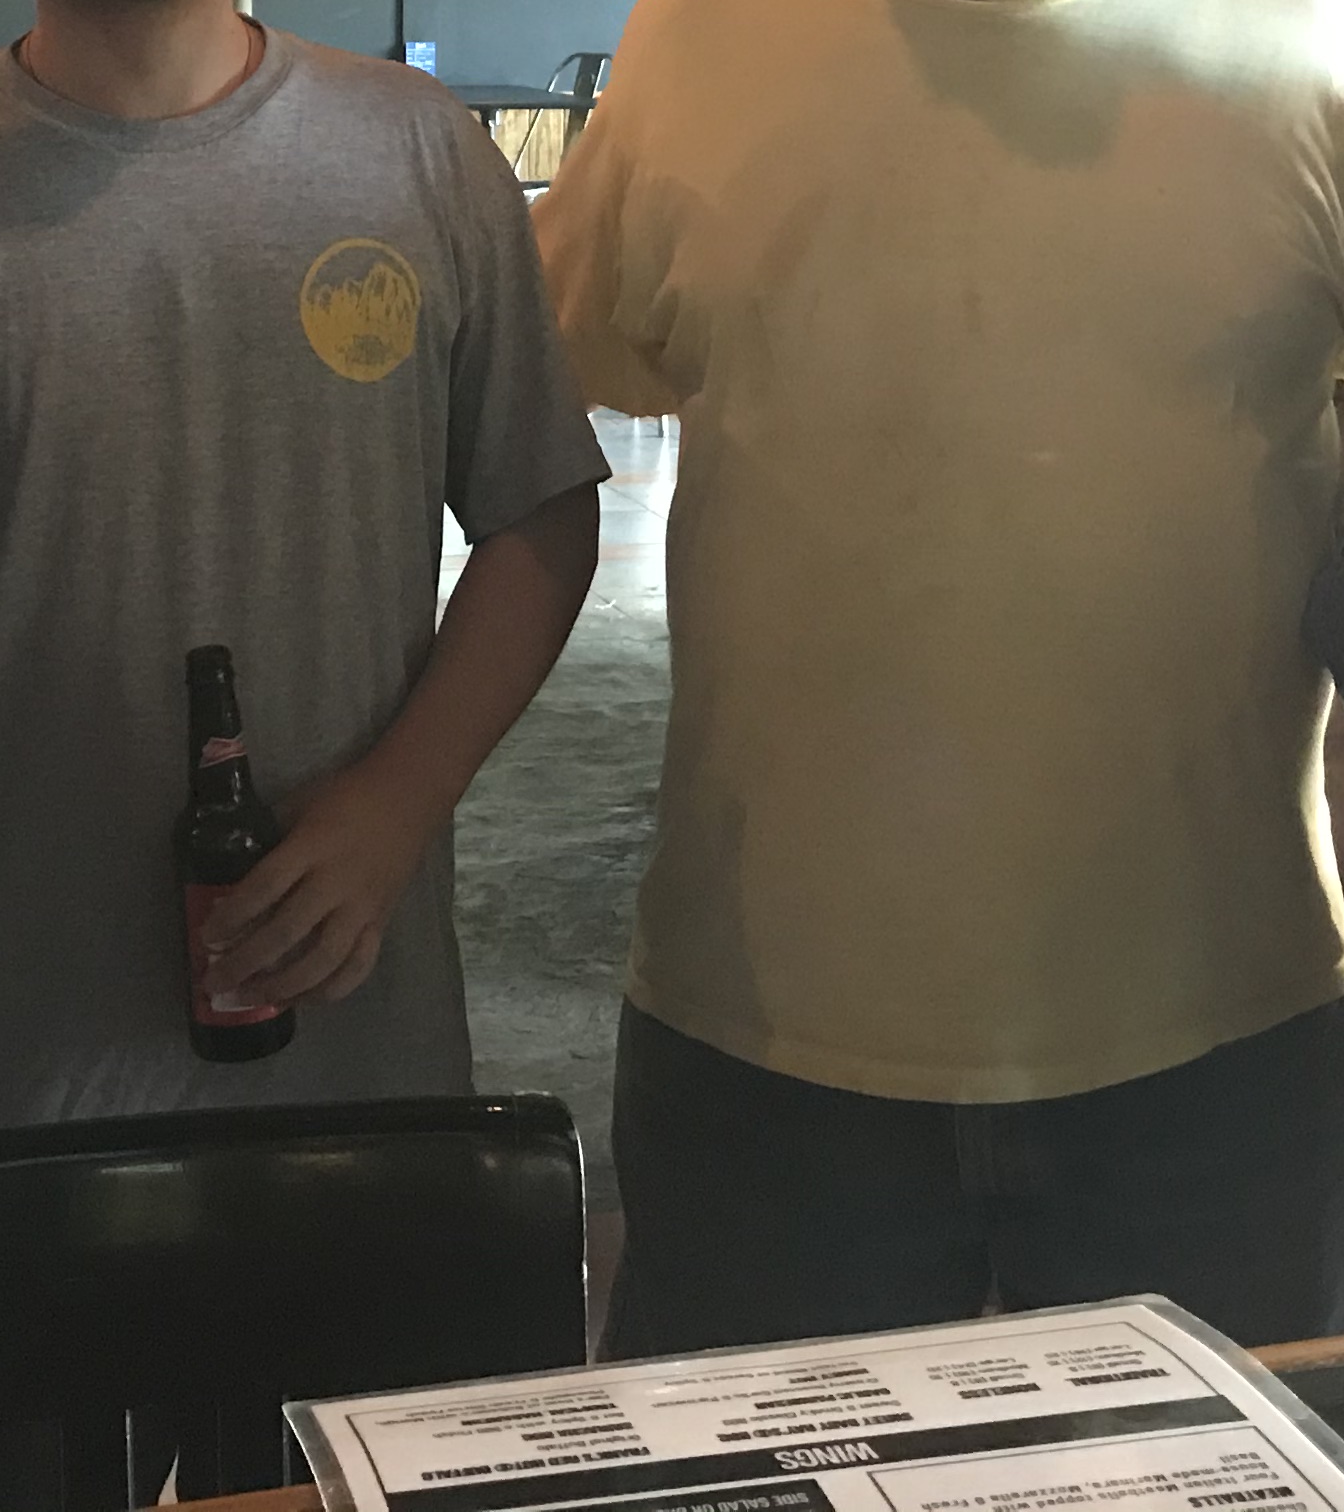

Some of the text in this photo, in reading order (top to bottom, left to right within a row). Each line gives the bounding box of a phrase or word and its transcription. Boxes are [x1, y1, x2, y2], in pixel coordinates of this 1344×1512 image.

[774, 1441, 879, 1470] WINGS
[717, 1496, 768, 1512] SALAD
[770, 1492, 809, 1506] SIDE
[1187, 1486, 1296, 1509] MEATBALLS
